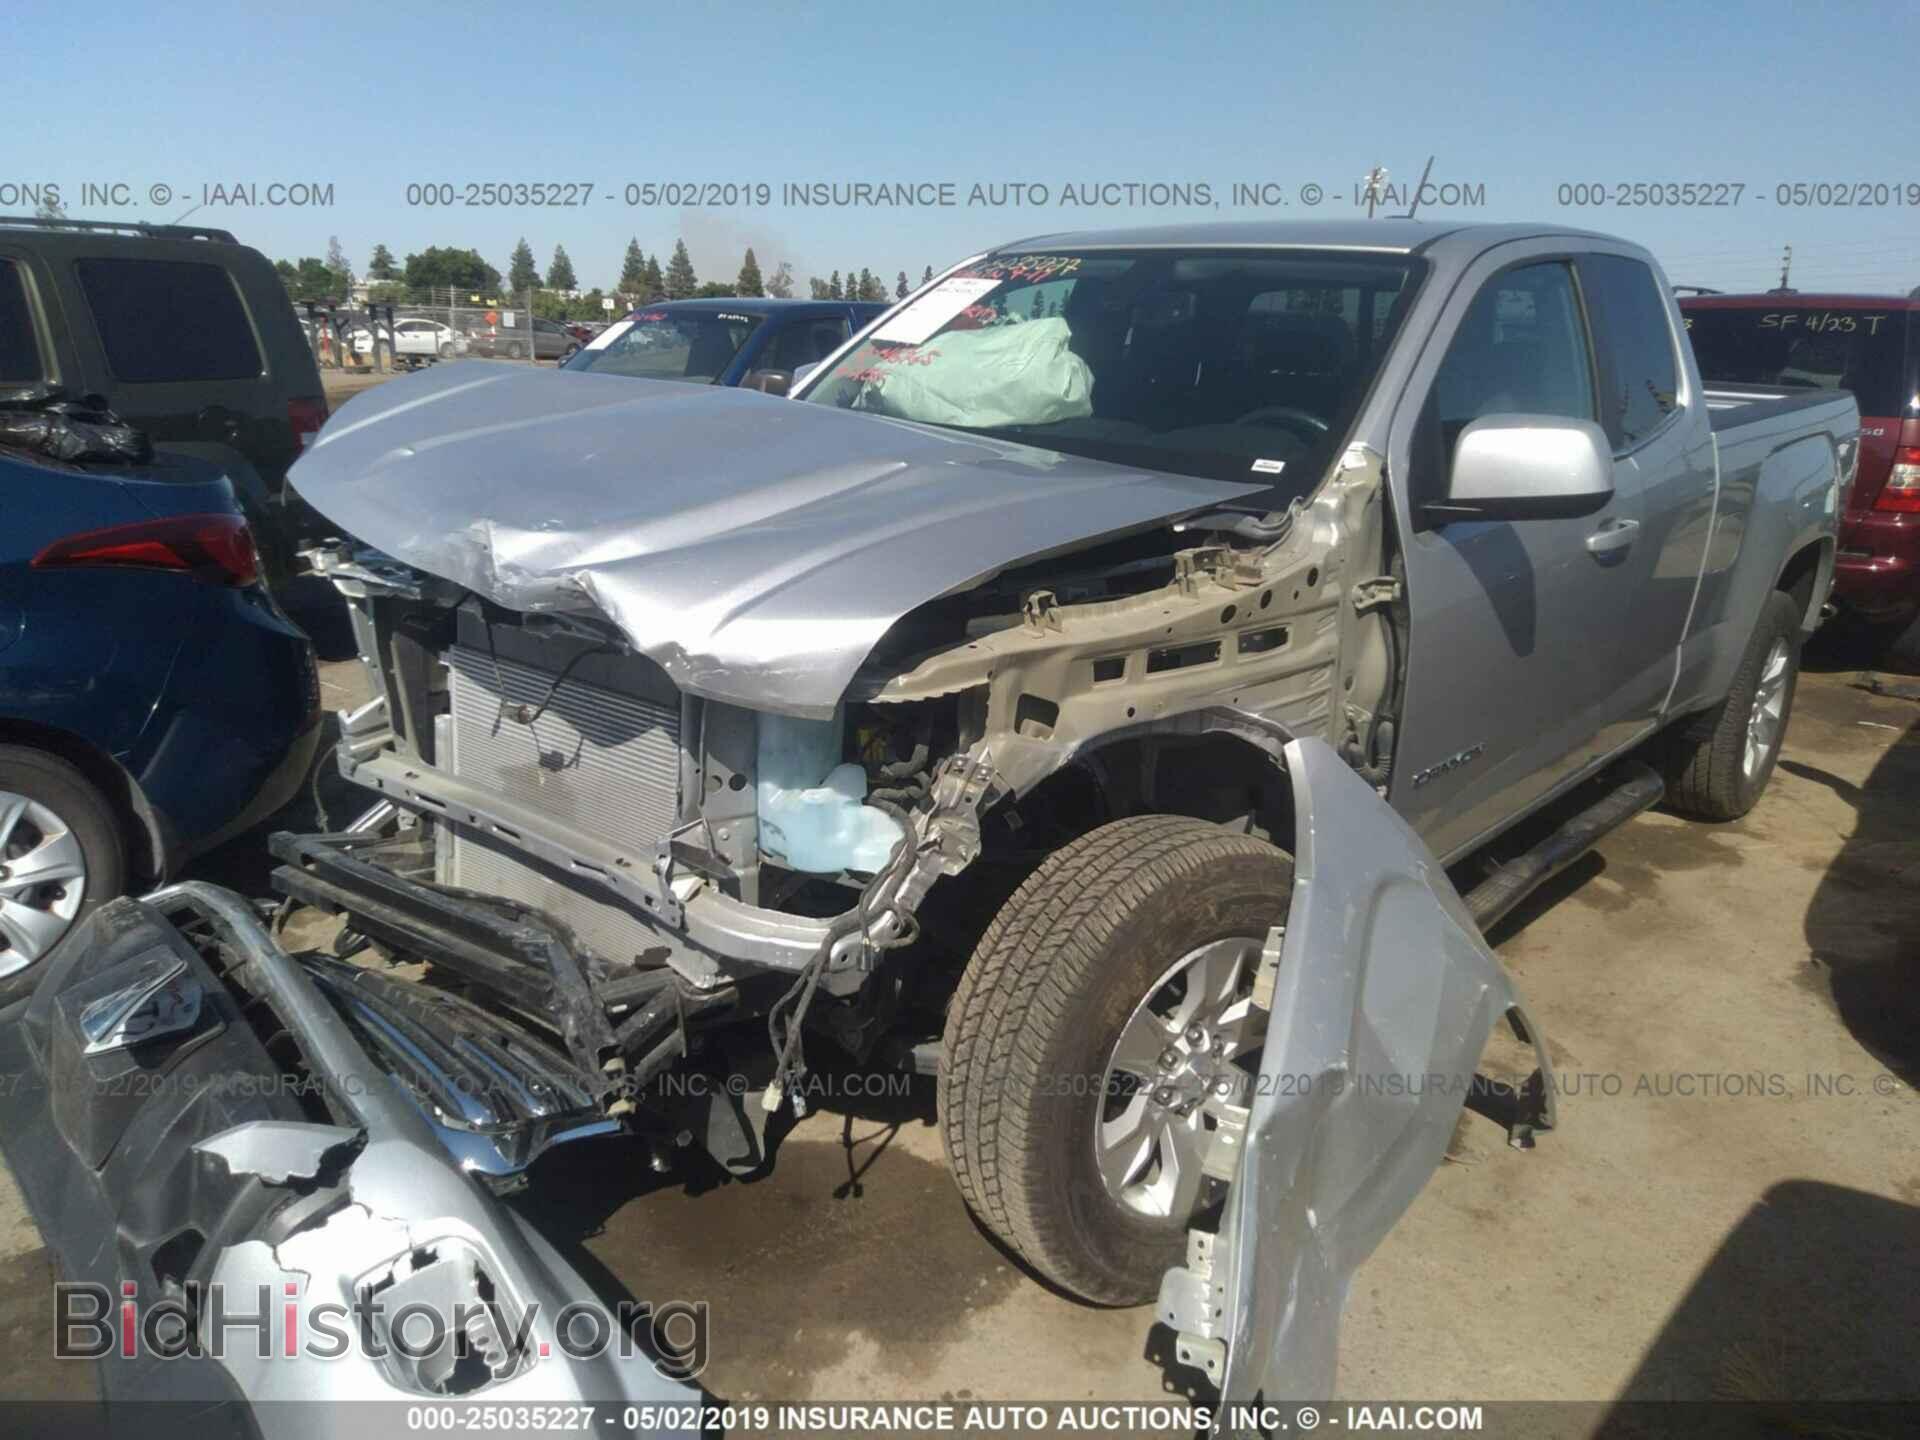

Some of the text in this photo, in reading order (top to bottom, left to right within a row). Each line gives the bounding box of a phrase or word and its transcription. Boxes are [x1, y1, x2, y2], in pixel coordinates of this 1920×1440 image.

[1758, 312, 1888, 335] SF 4/23 T
